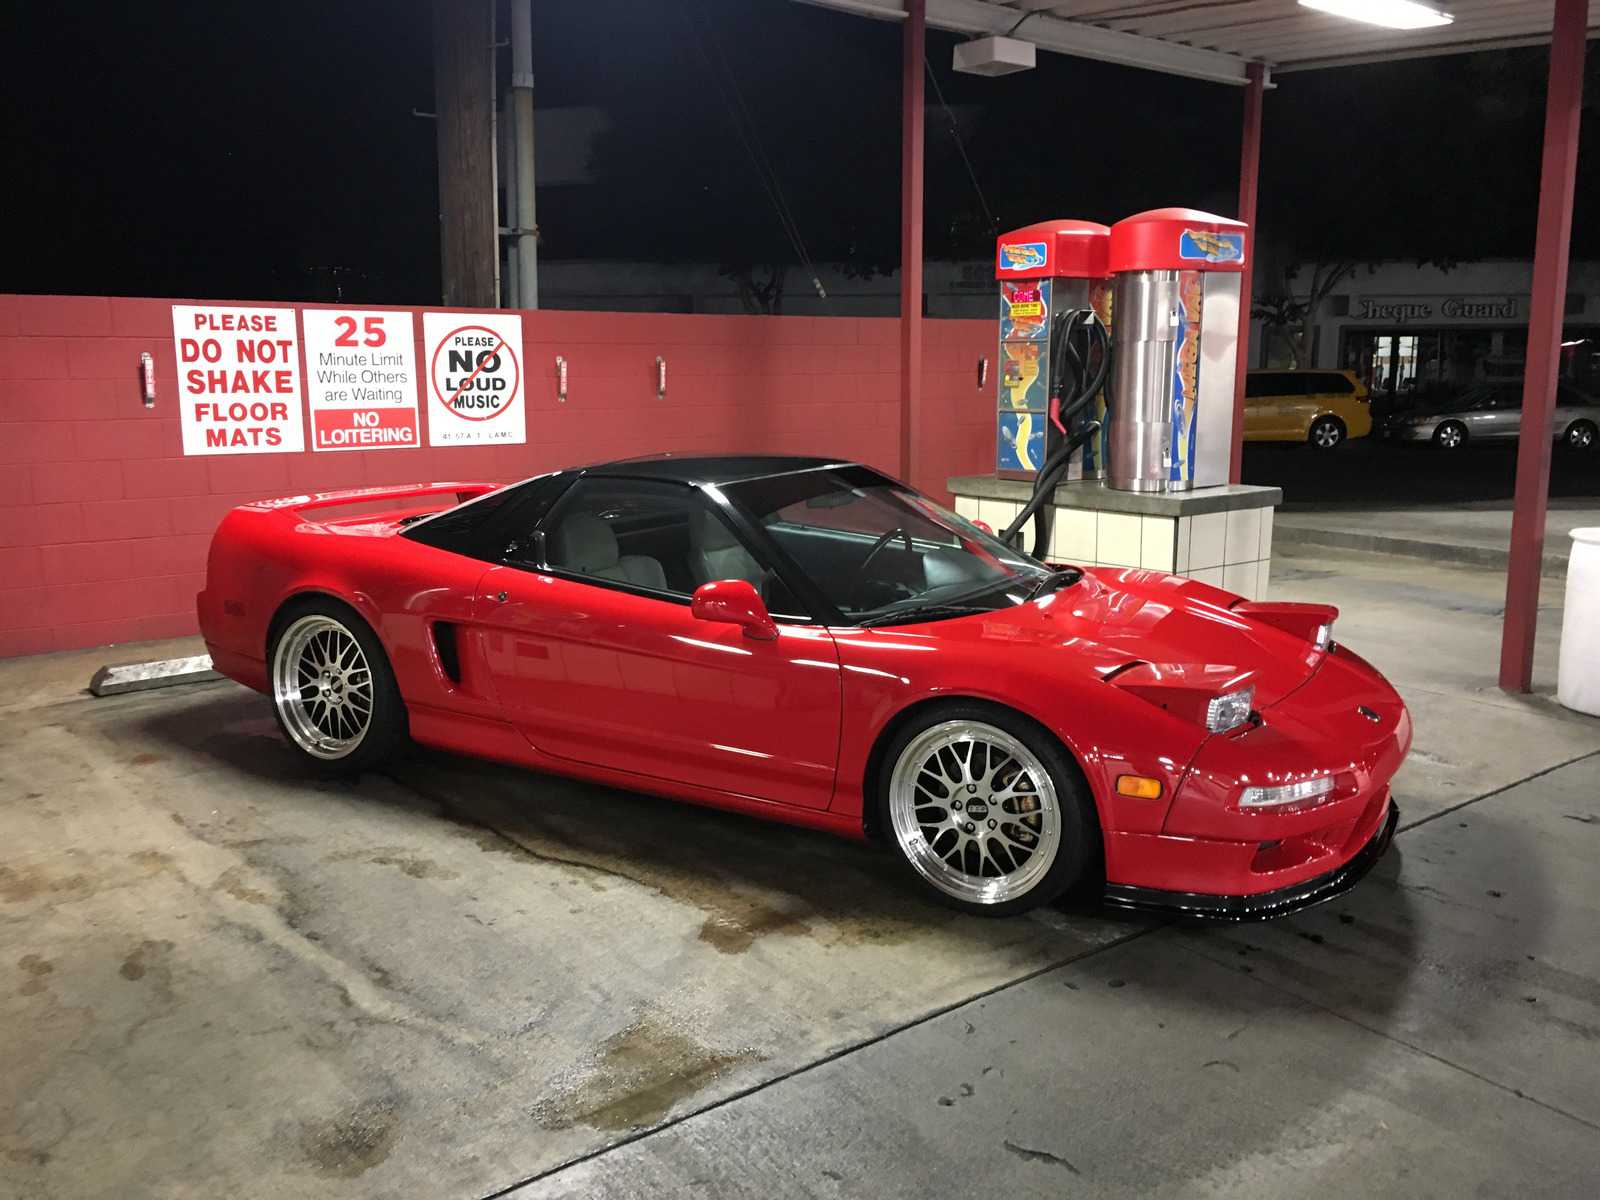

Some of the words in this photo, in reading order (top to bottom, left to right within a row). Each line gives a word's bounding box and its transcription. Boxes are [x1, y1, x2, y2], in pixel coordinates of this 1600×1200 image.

[1441, 298, 1516, 318] Guard
[194, 313, 277, 332] PLEASE
[334, 316, 387, 348] 25
[180, 338, 222, 363] DO
[236, 339, 293, 363] NOT
[455, 337, 494, 346] PLEASE
[319, 352, 367, 366] Minute
[371, 353, 403, 366] Limit
[448, 350, 501, 373] NO
[186, 369, 293, 394] SHAKE
[317, 370, 357, 384] While
[361, 370, 408, 384] Others
[445, 378, 506, 391] LOUD
[325, 390, 348, 401] are
[352, 388, 403, 403] Waiting
[454, 395, 500, 409] MUSIC
[194, 402, 288, 422] FLOOR
[353, 411, 380, 427] NO
[206, 427, 282, 447] MATS
[320, 427, 412, 445] LOITERING
